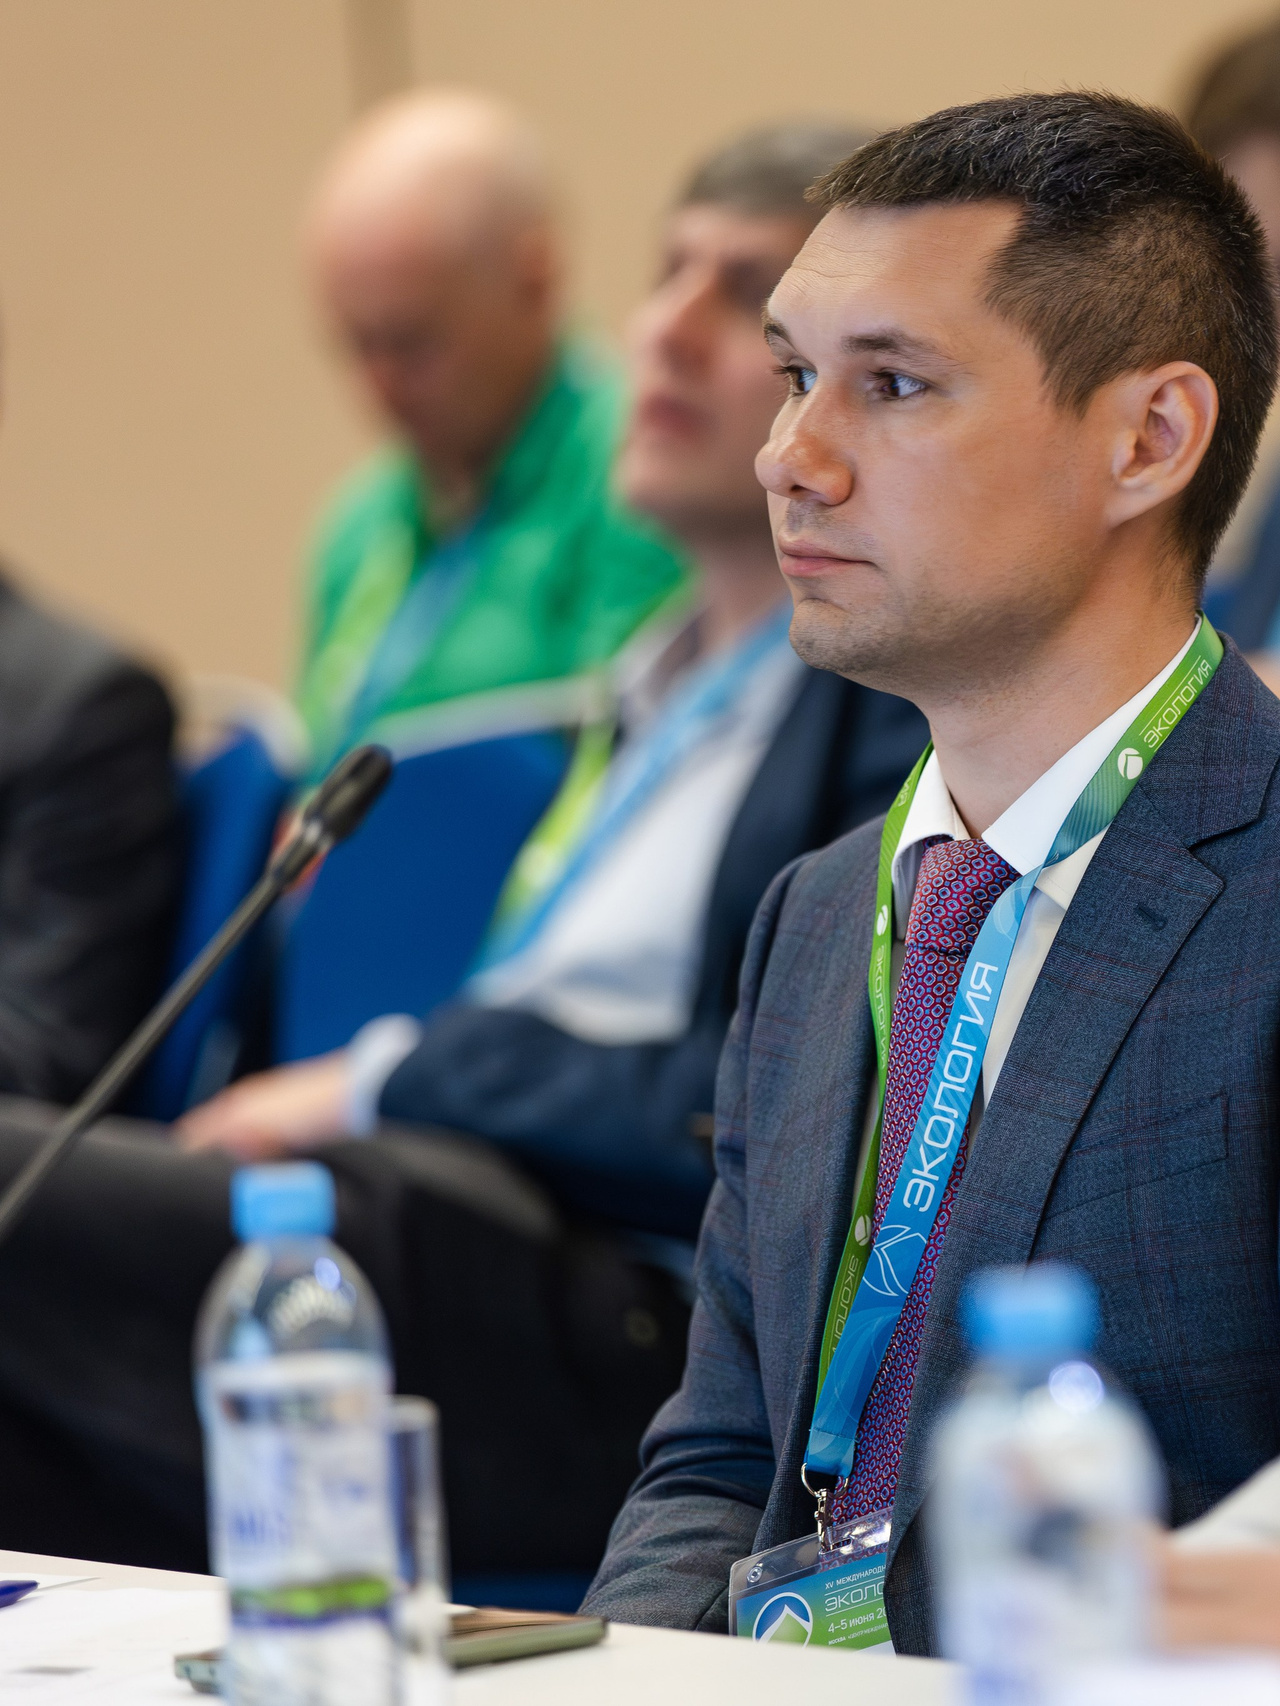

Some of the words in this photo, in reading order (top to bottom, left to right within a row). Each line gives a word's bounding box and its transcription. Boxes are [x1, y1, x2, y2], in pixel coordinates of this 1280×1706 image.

[1143, 659, 1213, 748] ЭКОЛОГИЯ
[902, 961, 999, 1212] ЭКОЛОГИЯ
[825, 1581, 834, 1590] XV
